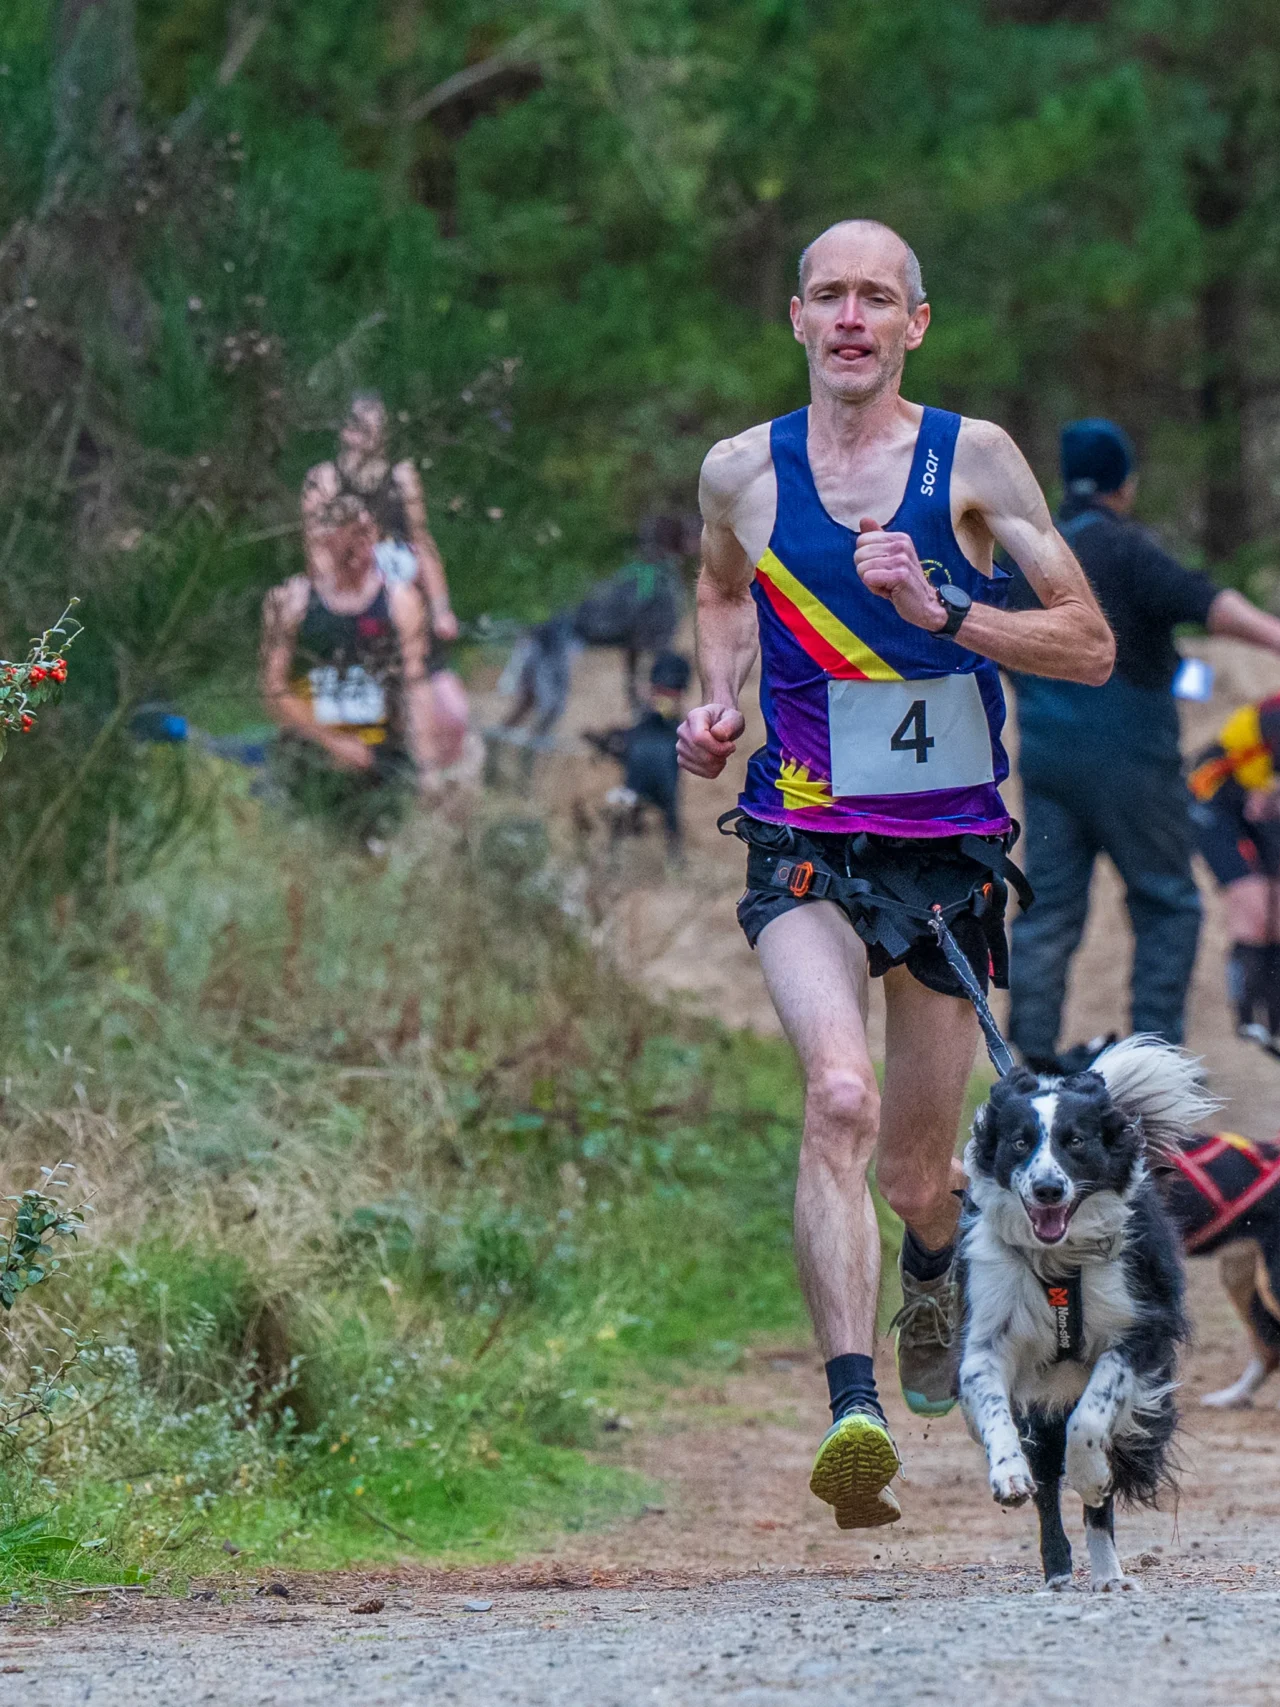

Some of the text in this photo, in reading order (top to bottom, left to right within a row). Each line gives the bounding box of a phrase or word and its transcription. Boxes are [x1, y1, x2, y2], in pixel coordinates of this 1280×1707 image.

[920, 448, 939, 497] soar
[890, 700, 935, 764] 4
[1058, 1306, 1071, 1348] Non-stop
